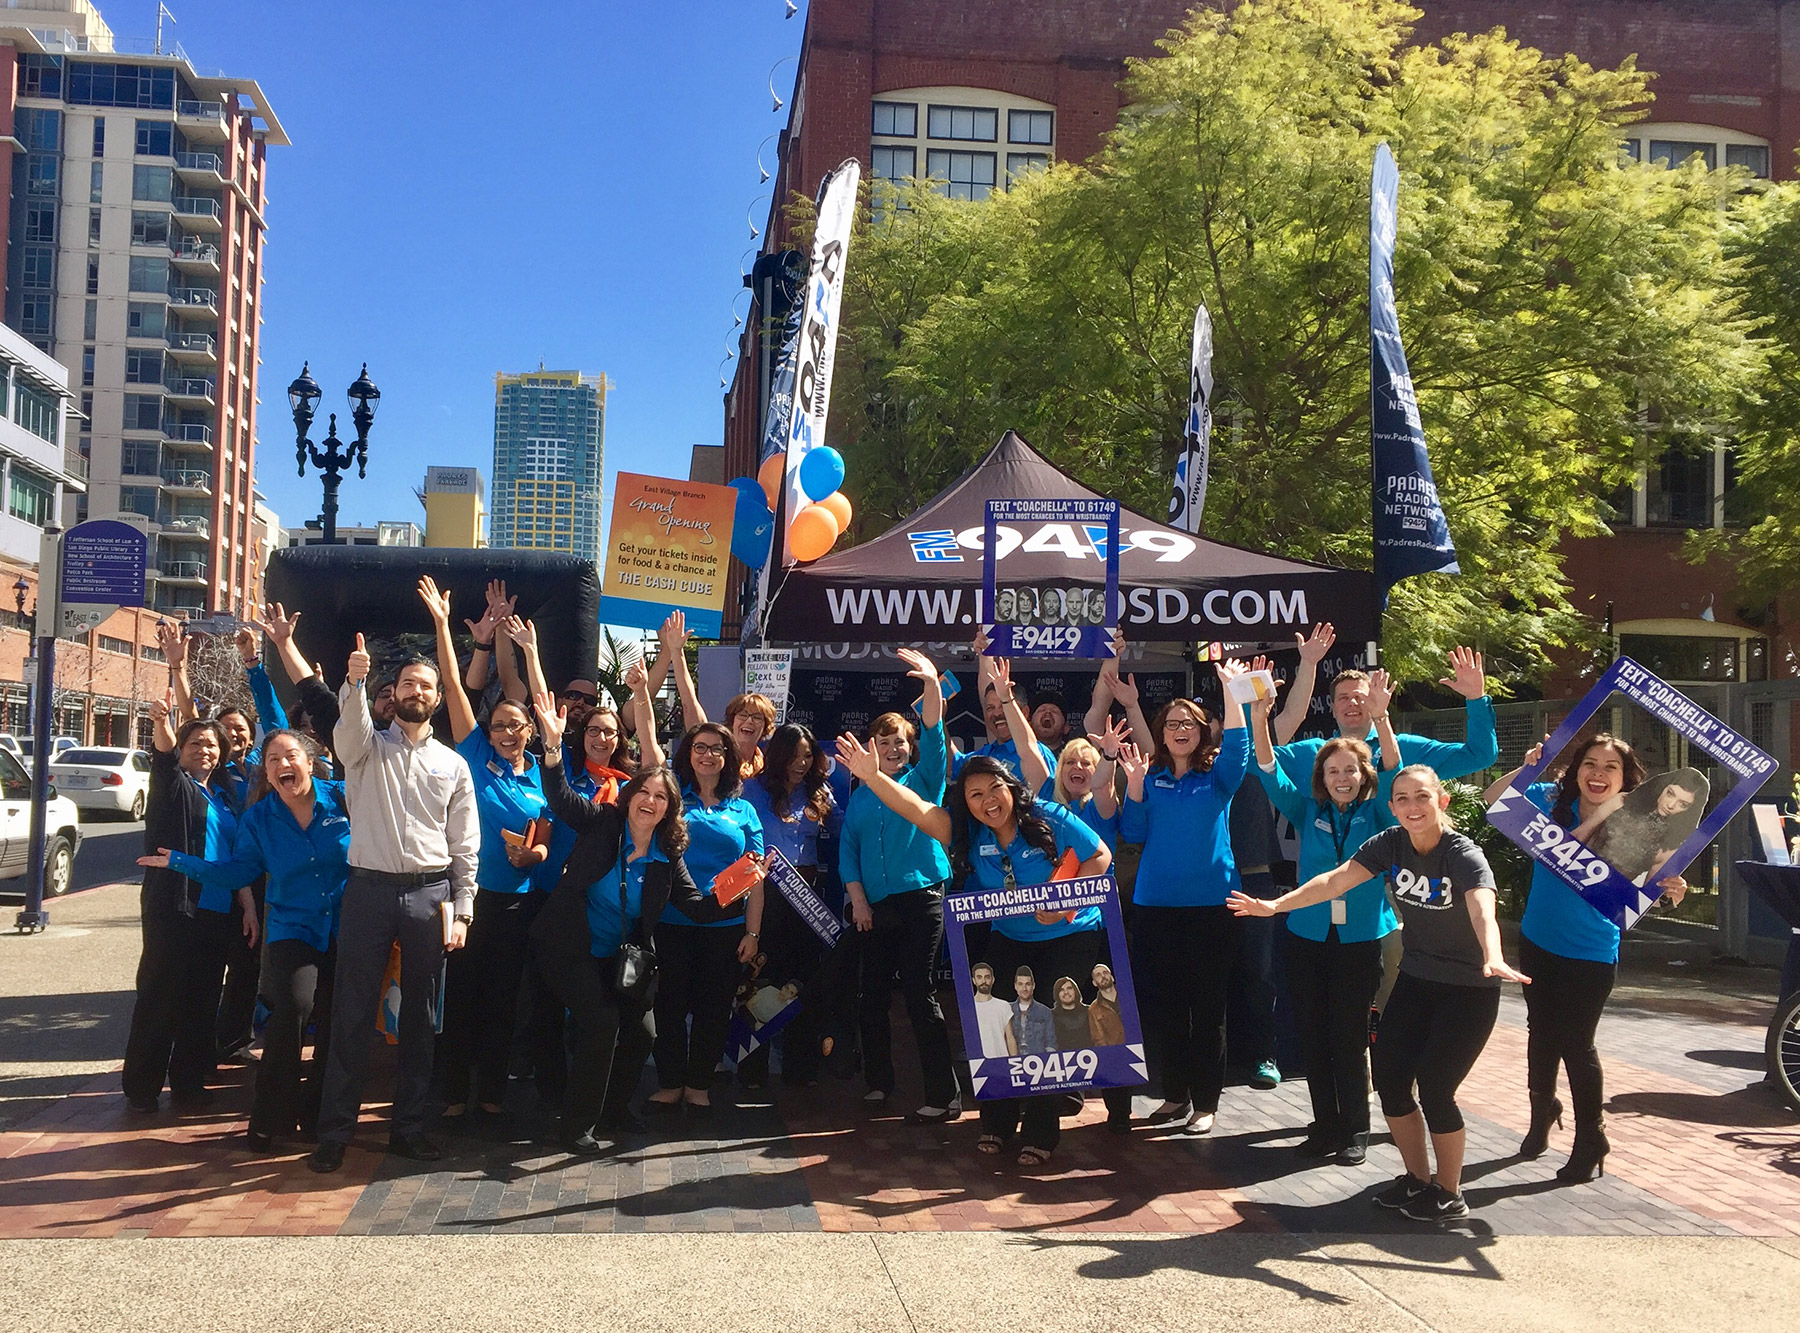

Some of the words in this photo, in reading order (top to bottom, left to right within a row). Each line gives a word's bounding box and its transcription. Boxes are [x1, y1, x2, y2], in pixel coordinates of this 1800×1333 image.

[644, 485, 658, 493] East
[660, 487, 681, 497] Village
[683, 490, 706, 500] Branch
[1395, 492, 1430, 506] RADIO
[629, 496, 676, 514] Grand
[989, 501, 1010, 512] TEXT
[1013, 501, 1071, 512] "COACHELLA"
[1074, 501, 1085, 512] TO
[1088, 501, 1116, 512] 61749
[658, 512, 713, 545] Opening
[619, 543, 635, 553] Get
[637, 545, 657, 557] your
[659, 547, 688, 560] tickets
[691, 552, 718, 564] inside
[907, 529, 964, 563] FM
[618, 555, 630, 565] for
[632, 558, 652, 568] food
[655, 560, 662, 570] &
[664, 563, 670, 571] a
[672, 562, 704, 575] chance
[707, 568, 716, 577] at
[618, 571, 641, 586] THE
[644, 574, 677, 591] CASH
[680, 580, 713, 595] CUBE
[1012, 627, 1024, 649] FM
[755, 672, 772, 681] text
[776, 673, 786, 681] us
[816, 677, 843, 686] PADRES
[871, 678, 898, 687] PADRES
[1036, 678, 1063, 687] PADRES
[1145, 679, 1173, 688] PADRES
[841, 711, 869, 722] PADRES
[1614, 676, 1628, 690] FOR
[1628, 685, 1642, 699] THE
[1638, 694, 1659, 711] MOST
[1657, 704, 1689, 732] CHANCES
[1686, 727, 1696, 738] TO
[1695, 733, 1709, 748] WIN
[1708, 743, 1754, 779] WRISTBANDS!
[1618, 660, 1648, 684] TEXT
[1648, 680, 1718, 733] "COACHELLA"
[1715, 728, 1735, 747] TO
[1731, 741, 1772, 774] 61749
[1521, 812, 1550, 842] FM
[1556, 867, 1584, 891] ALTERNATIVE
[785, 869, 831, 921] "COACHELLA"
[826, 919, 840, 935] TO
[948, 896, 975, 912] TEXT
[978, 886, 1053, 908] "COACHELLA"
[1056, 883, 1071, 897] TO
[1074, 878, 1111, 896] 61749
[769, 871, 779, 882] THE
[777, 880, 792, 895] MOST
[789, 893, 810, 916] CHANCES
[807, 914, 815, 922] TO
[812, 920, 824, 932] WIN
[821, 929, 836, 949] WRIST
[956, 913, 970, 922] FOR
[970, 911, 984, 921] THE
[985, 909, 1003, 918] MOST
[1004, 904, 1035, 916] CHANCES
[1036, 902, 1045, 911] TO
[1046, 900, 1060, 910] WIN
[1062, 895, 1107, 908] WRISTBANDS!
[1008, 1057, 1026, 1087] FM
